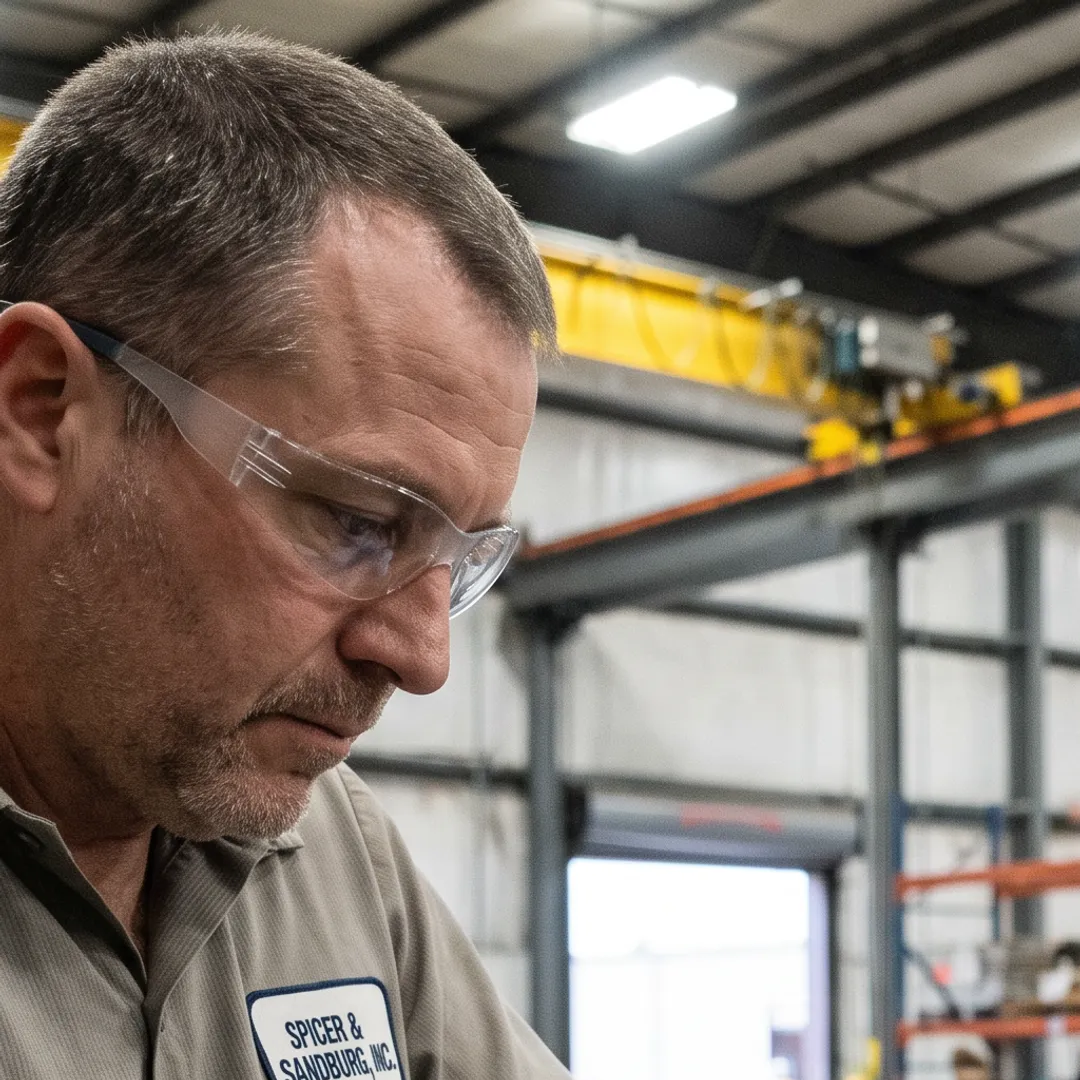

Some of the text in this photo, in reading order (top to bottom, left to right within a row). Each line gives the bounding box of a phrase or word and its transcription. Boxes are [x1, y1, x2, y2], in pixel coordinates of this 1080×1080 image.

[285, 1012, 364, 1049] SPICER &
[369, 1042, 397, 1073] INC.
